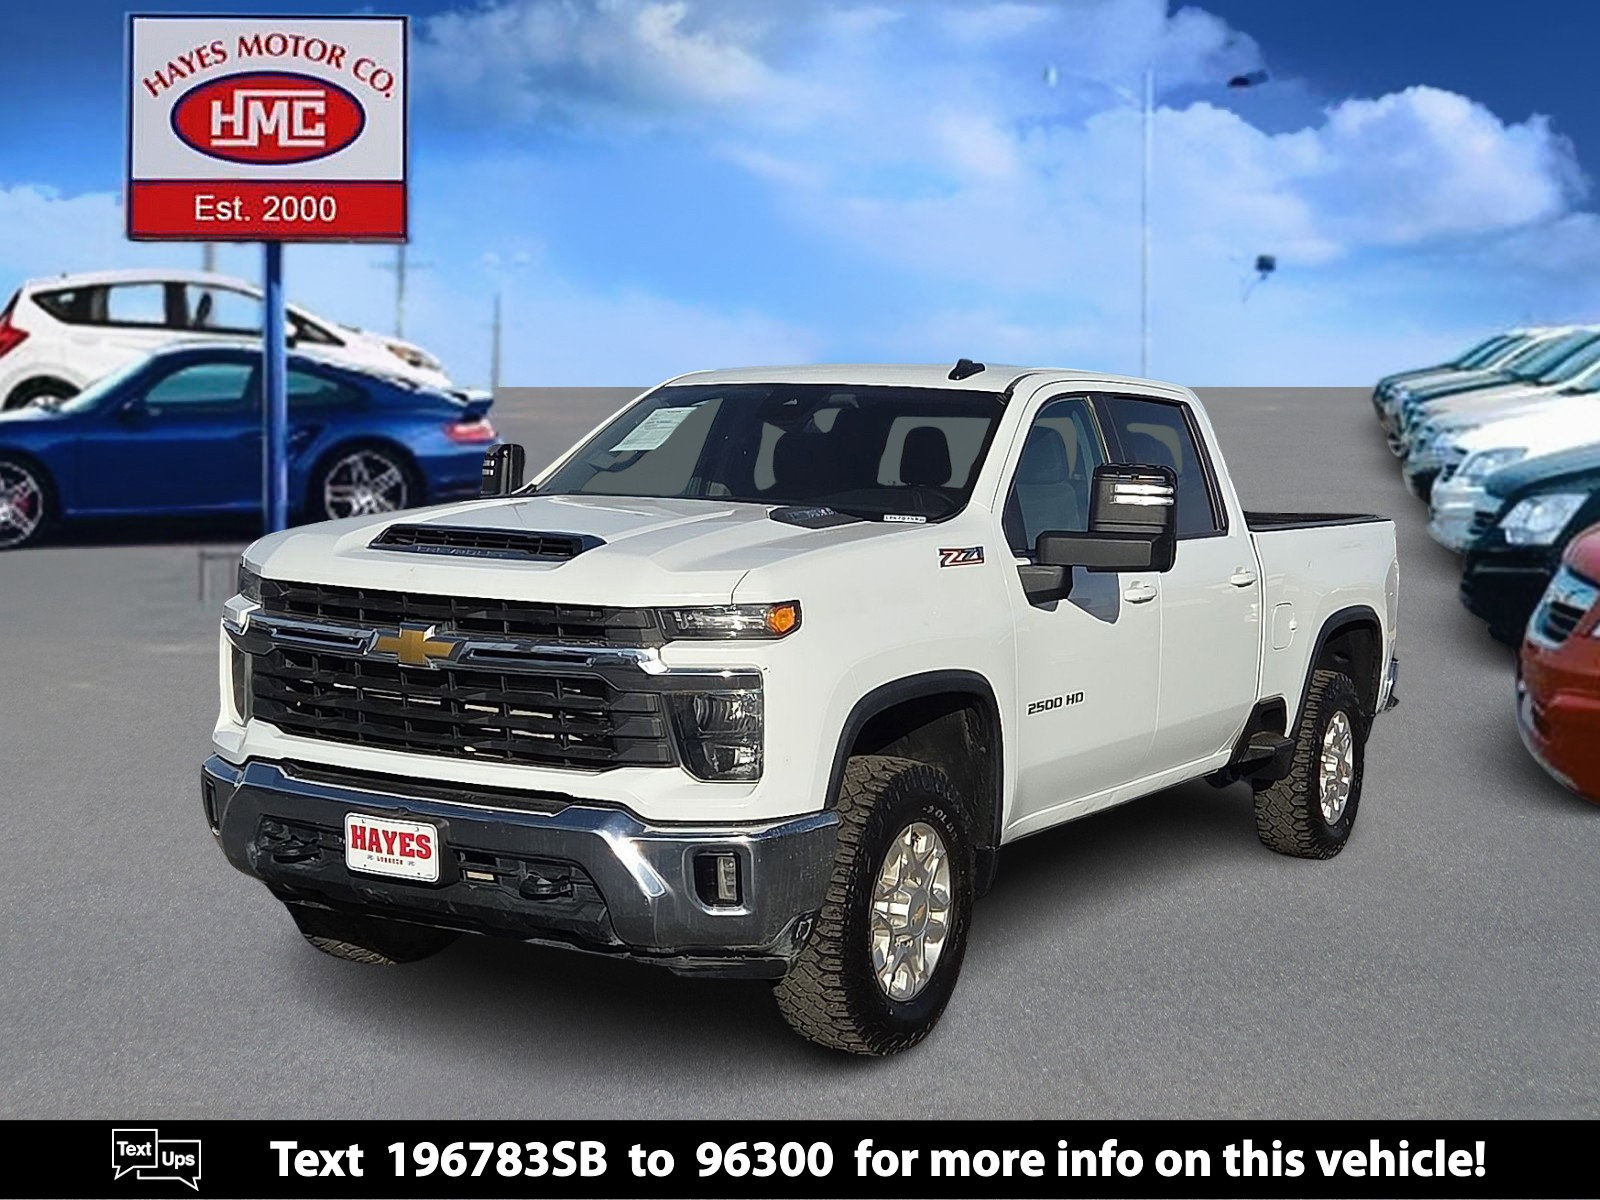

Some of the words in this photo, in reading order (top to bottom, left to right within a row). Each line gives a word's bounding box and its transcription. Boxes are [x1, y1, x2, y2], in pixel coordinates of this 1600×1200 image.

[142, 40, 228, 98] HAYES
[237, 33, 347, 69] MOTOR
[352, 58, 394, 98] CO.
[210, 89, 326, 147] HMC
[195, 194, 250, 221] Est.
[262, 195, 336, 221] 2000
[1028, 697, 1062, 715] 2500
[1066, 691, 1084, 706] HD
[351, 825, 432, 859] HAYES
